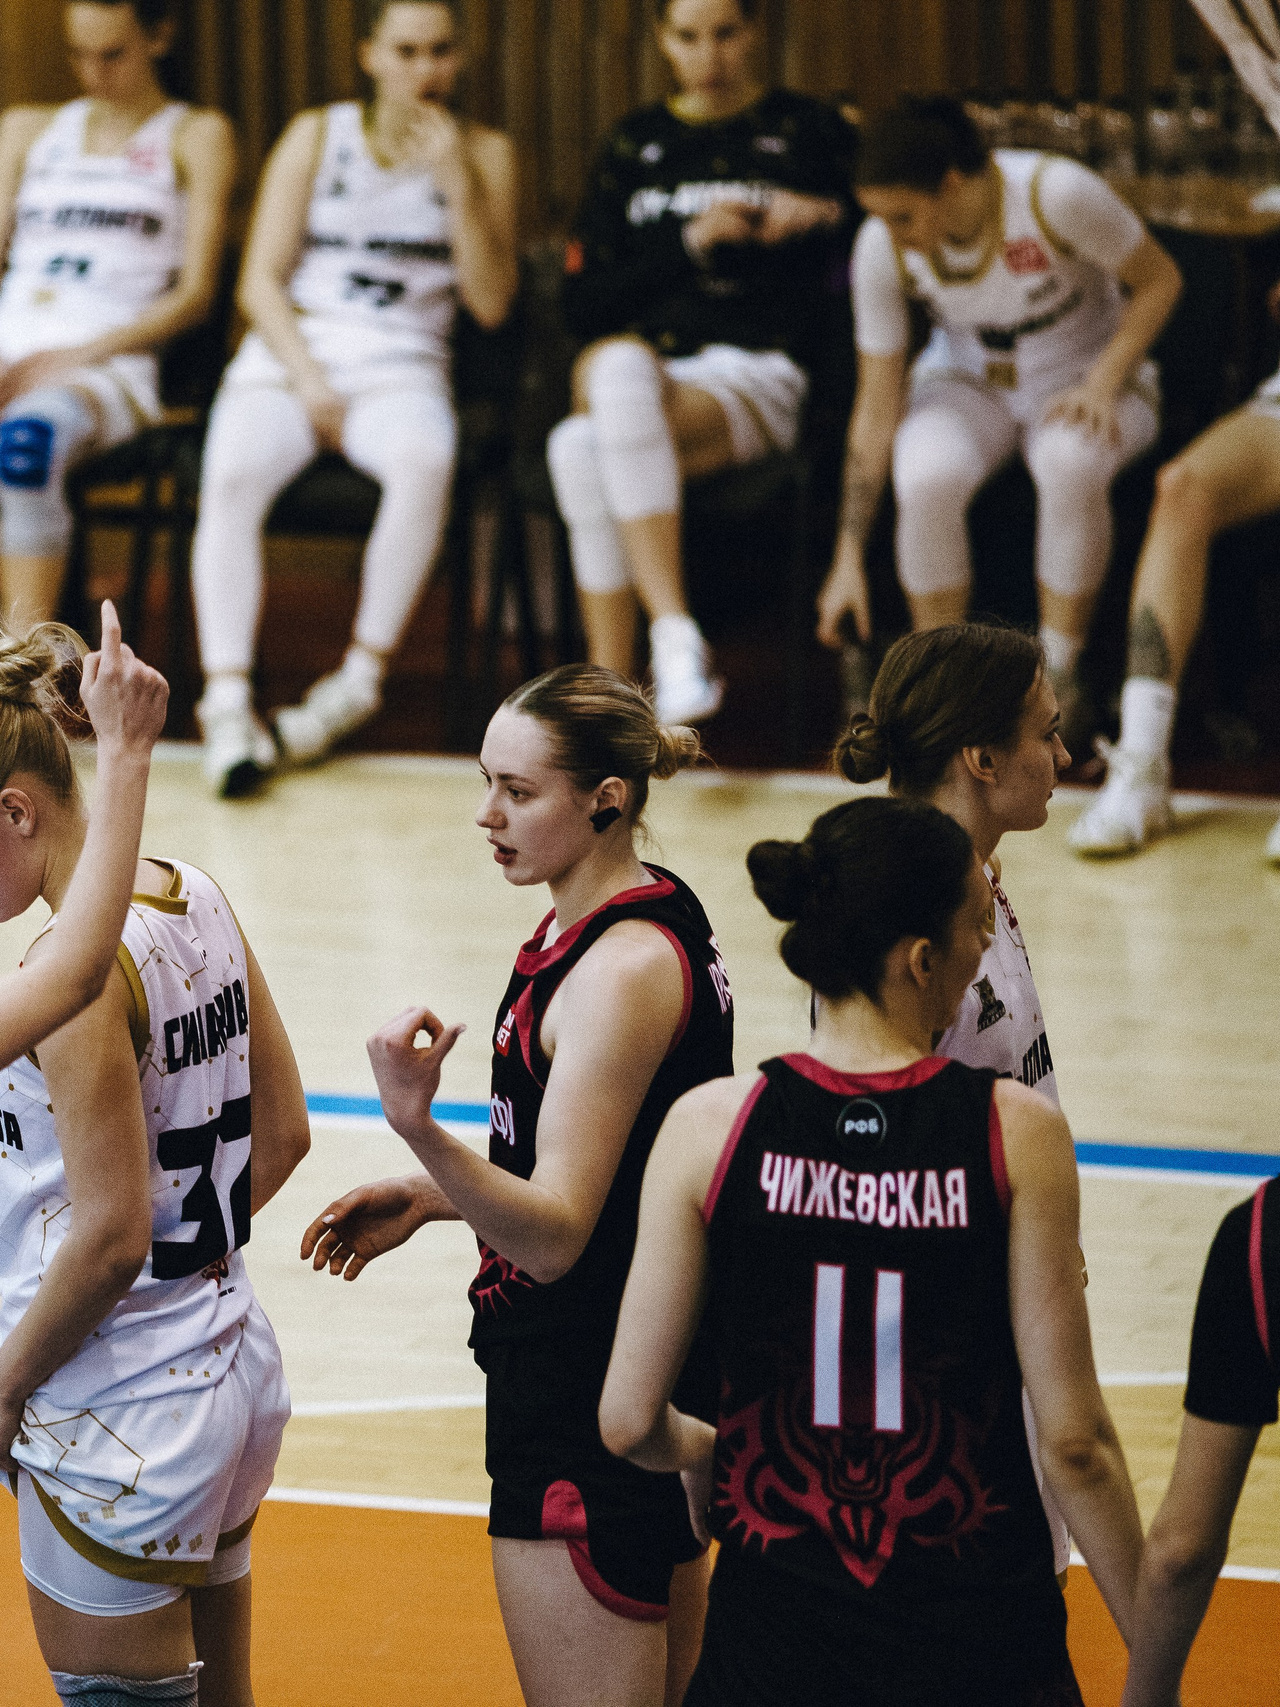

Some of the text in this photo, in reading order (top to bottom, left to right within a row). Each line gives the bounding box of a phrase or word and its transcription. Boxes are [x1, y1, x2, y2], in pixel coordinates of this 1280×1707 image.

[844, 1118, 880, 1135] РФБ
[759, 1150, 969, 1229] ЧИЖЕВСКАЯ
[812, 1264, 904, 1434] 11
